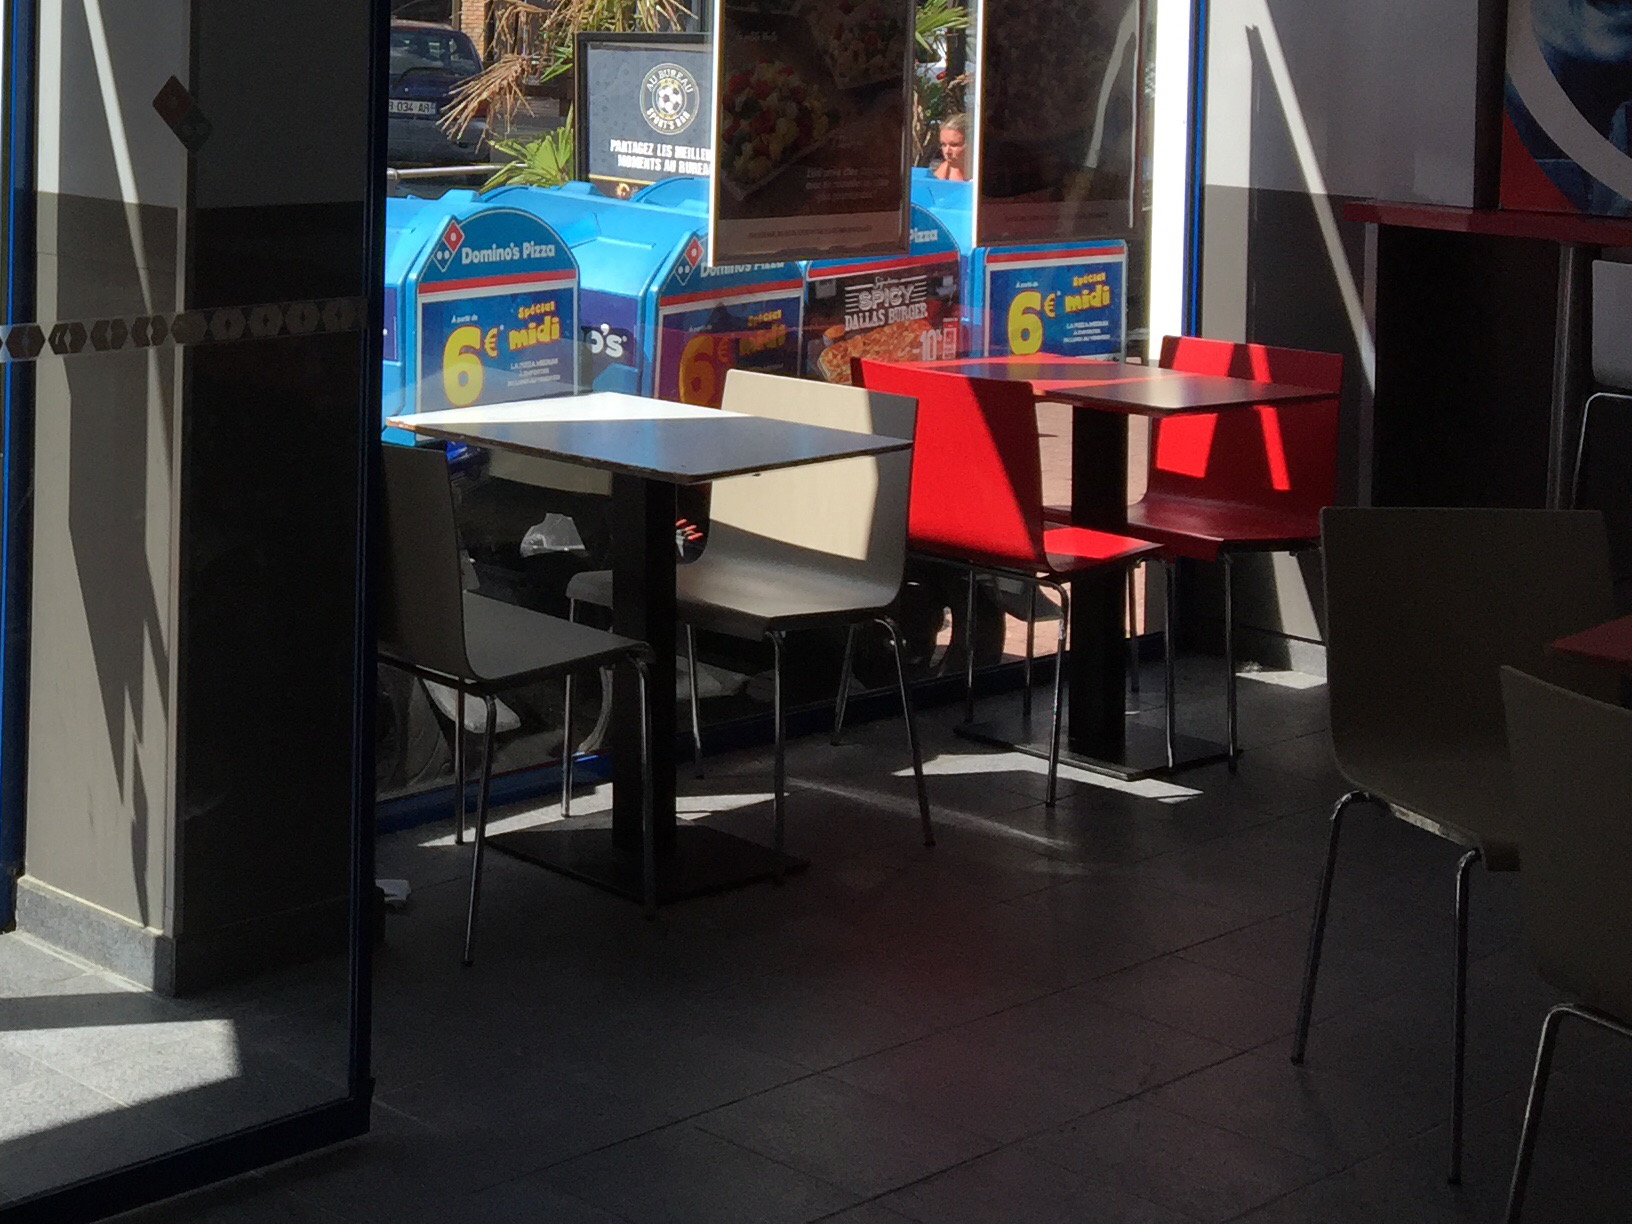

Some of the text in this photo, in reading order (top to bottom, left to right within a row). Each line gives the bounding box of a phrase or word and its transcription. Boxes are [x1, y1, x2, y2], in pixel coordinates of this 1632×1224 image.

[610, 138, 654, 156] PARTAGEZ
[656, 142, 673, 158] LES
[617, 154, 662, 172] MOMENTS
[663, 158, 676, 173] AU
[461, 240, 556, 265] Domino's Pizza
[858, 284, 915, 311] SPICY
[1064, 284, 1111, 314] midi
[844, 302, 928, 332] DALLAS BURGER
[508, 315, 561, 352] midi
